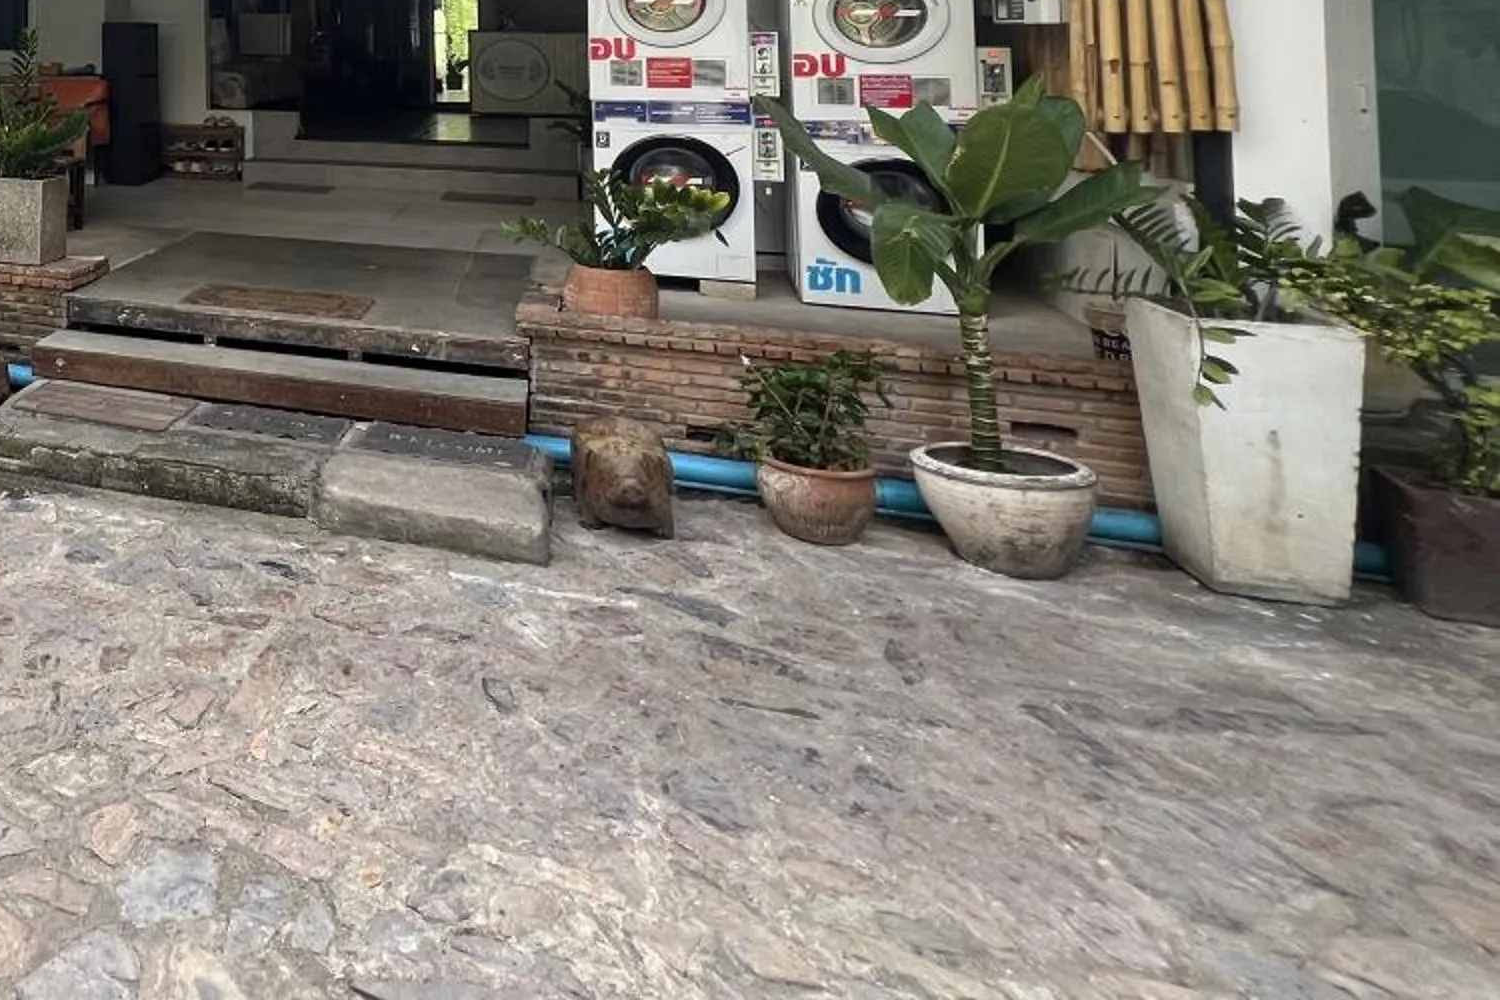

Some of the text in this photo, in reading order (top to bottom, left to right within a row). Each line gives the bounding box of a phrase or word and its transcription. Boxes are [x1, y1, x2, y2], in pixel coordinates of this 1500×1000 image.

[589, 37, 636, 61] อบ
[792, 53, 847, 78] อบ
[806, 257, 861, 294] ซัก
